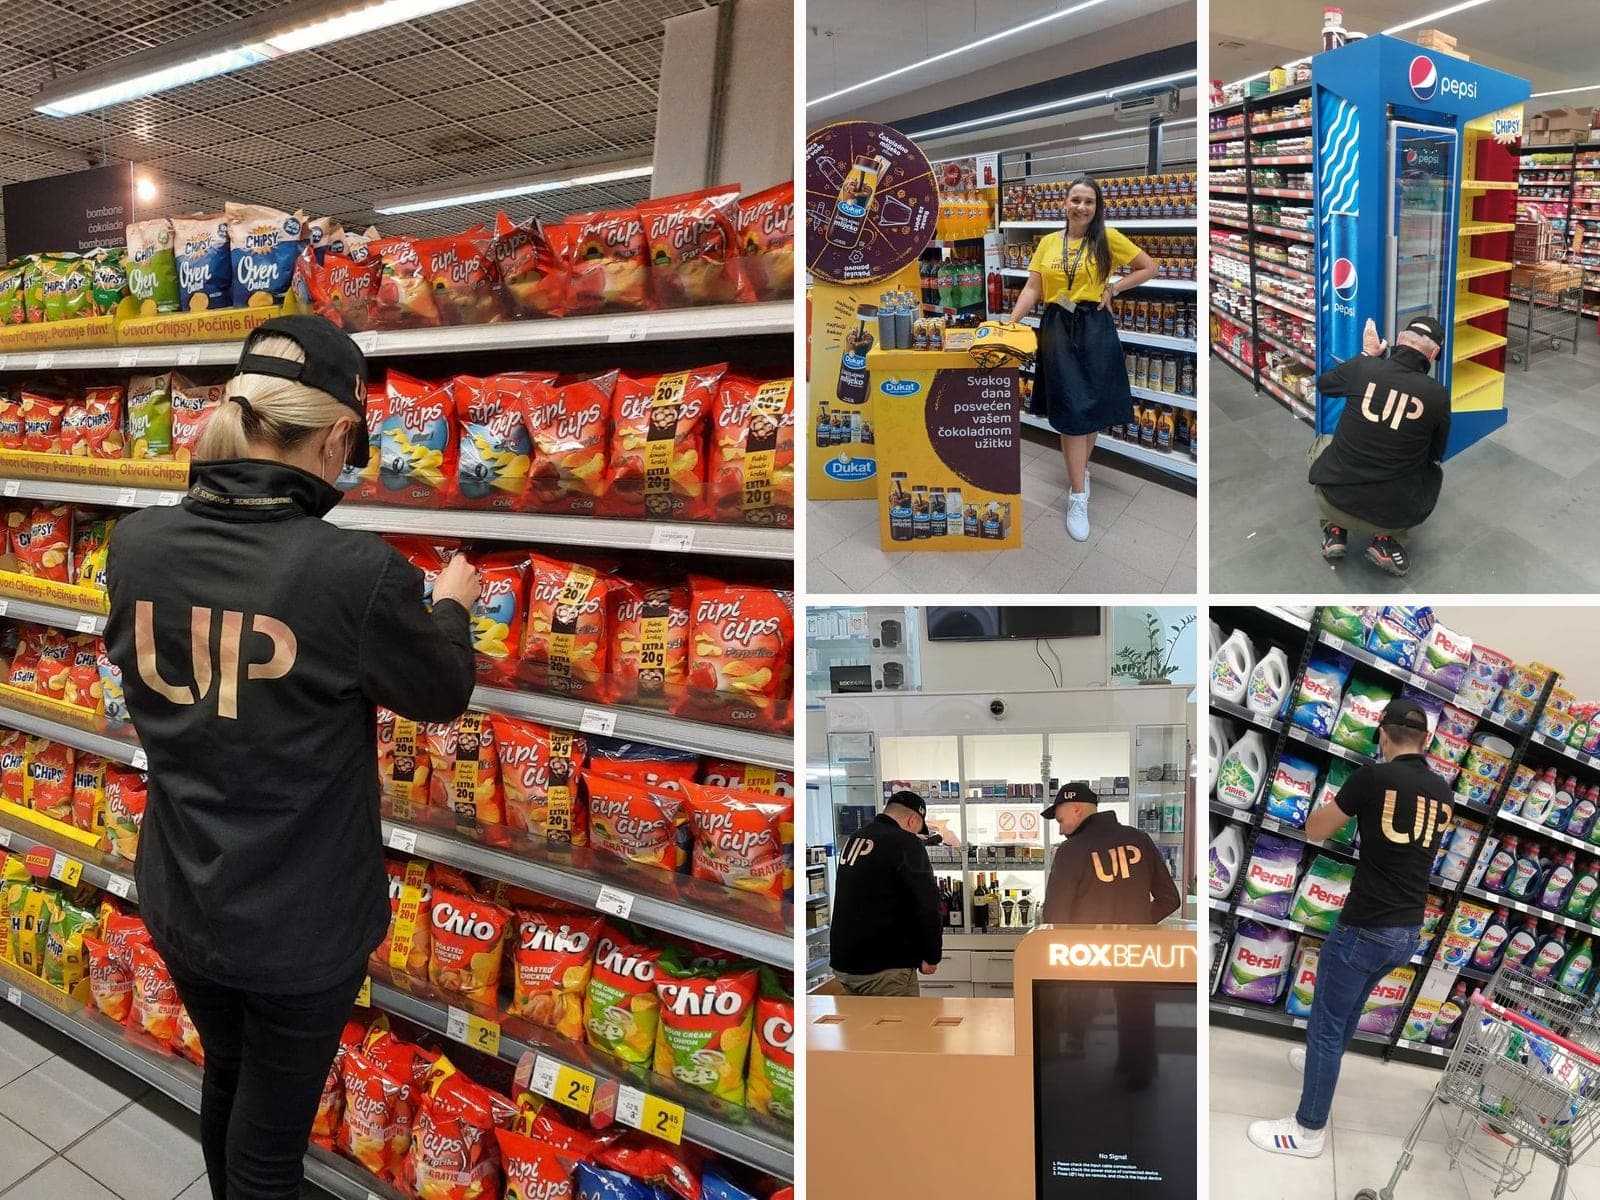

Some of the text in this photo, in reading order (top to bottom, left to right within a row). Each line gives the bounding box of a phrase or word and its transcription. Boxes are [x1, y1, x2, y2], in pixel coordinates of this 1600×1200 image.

[1441, 77, 1477, 100] pepsi
[878, 132, 908, 154] Čokoladno
[880, 141, 901, 156] mlijeko
[1418, 153, 1439, 165] pepsi
[87, 206, 123, 218] bombone
[841, 204, 862, 214] Dukat
[88, 220, 124, 234] čokolade
[79, 236, 125, 249] bombonjere
[180, 262, 211, 287] Oven
[238, 256, 278, 283] Oven
[129, 269, 159, 294] Oven
[1334, 303, 1354, 316] pepsi
[52, 326, 84, 339] Počinje
[123, 324, 153, 336] Otvori
[197, 317, 241, 333] Počinje
[845, 356, 864, 365] Dukat
[886, 383, 915, 391] Dukat
[968, 376, 1011, 388] Svakog
[981, 389, 1011, 398] dana
[954, 400, 1011, 414] posvećen
[1361, 382, 1424, 430] UP
[972, 414, 1011, 423] vašem
[938, 426, 1011, 436] čokoladnom
[975, 438, 1012, 448] užitku
[53, 461, 87, 477] Počinje
[120, 464, 188, 482] Otvori Chipsy
[647, 467, 670, 477] EXTRA
[832, 463, 872, 472] Dukat
[746, 480, 770, 489] EXTRA
[642, 643, 664, 651] EXTRA
[1435, 632, 1470, 662] Persil
[134, 599, 298, 719] UP
[550, 656, 570, 664] EXTRA
[1482, 653, 1499, 665] Persil
[1301, 675, 1335, 700] Persil
[1472, 679, 1490, 691] Persil
[731, 711, 756, 720] Chio
[1351, 700, 1386, 722] Persil
[1454, 713, 1470, 724] Persil
[1445, 739, 1461, 749] Persil
[747, 778, 770, 786] EXTRA
[1276, 769, 1311, 794] Persil
[1225, 786, 1247, 798] ARIEL
[1381, 789, 1453, 848] UP
[1091, 845, 1142, 882] UP
[1494, 857, 1510, 868] Persil
[68, 867, 74, 880] 2
[1250, 864, 1293, 888] Persil
[1552, 872, 1569, 885] Persil
[1578, 881, 1594, 892] Persil
[1308, 883, 1347, 906] Persi
[1461, 906, 1484, 919] Persil
[432, 902, 495, 941] Chio
[520, 922, 590, 953] Chio
[1446, 935, 1469, 948] Persil
[1485, 932, 1503, 943] Persil
[436, 942, 464, 955] ROASTED
[1511, 938, 1531, 952] Persil
[595, 937, 655, 982] Chio
[1237, 947, 1282, 969] Persil
[1541, 949, 1561, 963] Persil
[520, 966, 553, 974] ROASTED
[1573, 960, 1589, 969] Persil
[520, 973, 551, 981] CHICKEN
[603, 986, 625, 999] CREAM
[1369, 985, 1406, 1000] ersil
[657, 984, 742, 1015] Chio
[1410, 1009, 1432, 1020] Persil
[479, 1028, 488, 1044] 2
[665, 1028, 685, 1038] SOUR
[674, 1037, 699, 1045] ONION
[568, 1081, 590, 1101] 2 45
[658, 1112, 669, 1131] 2
